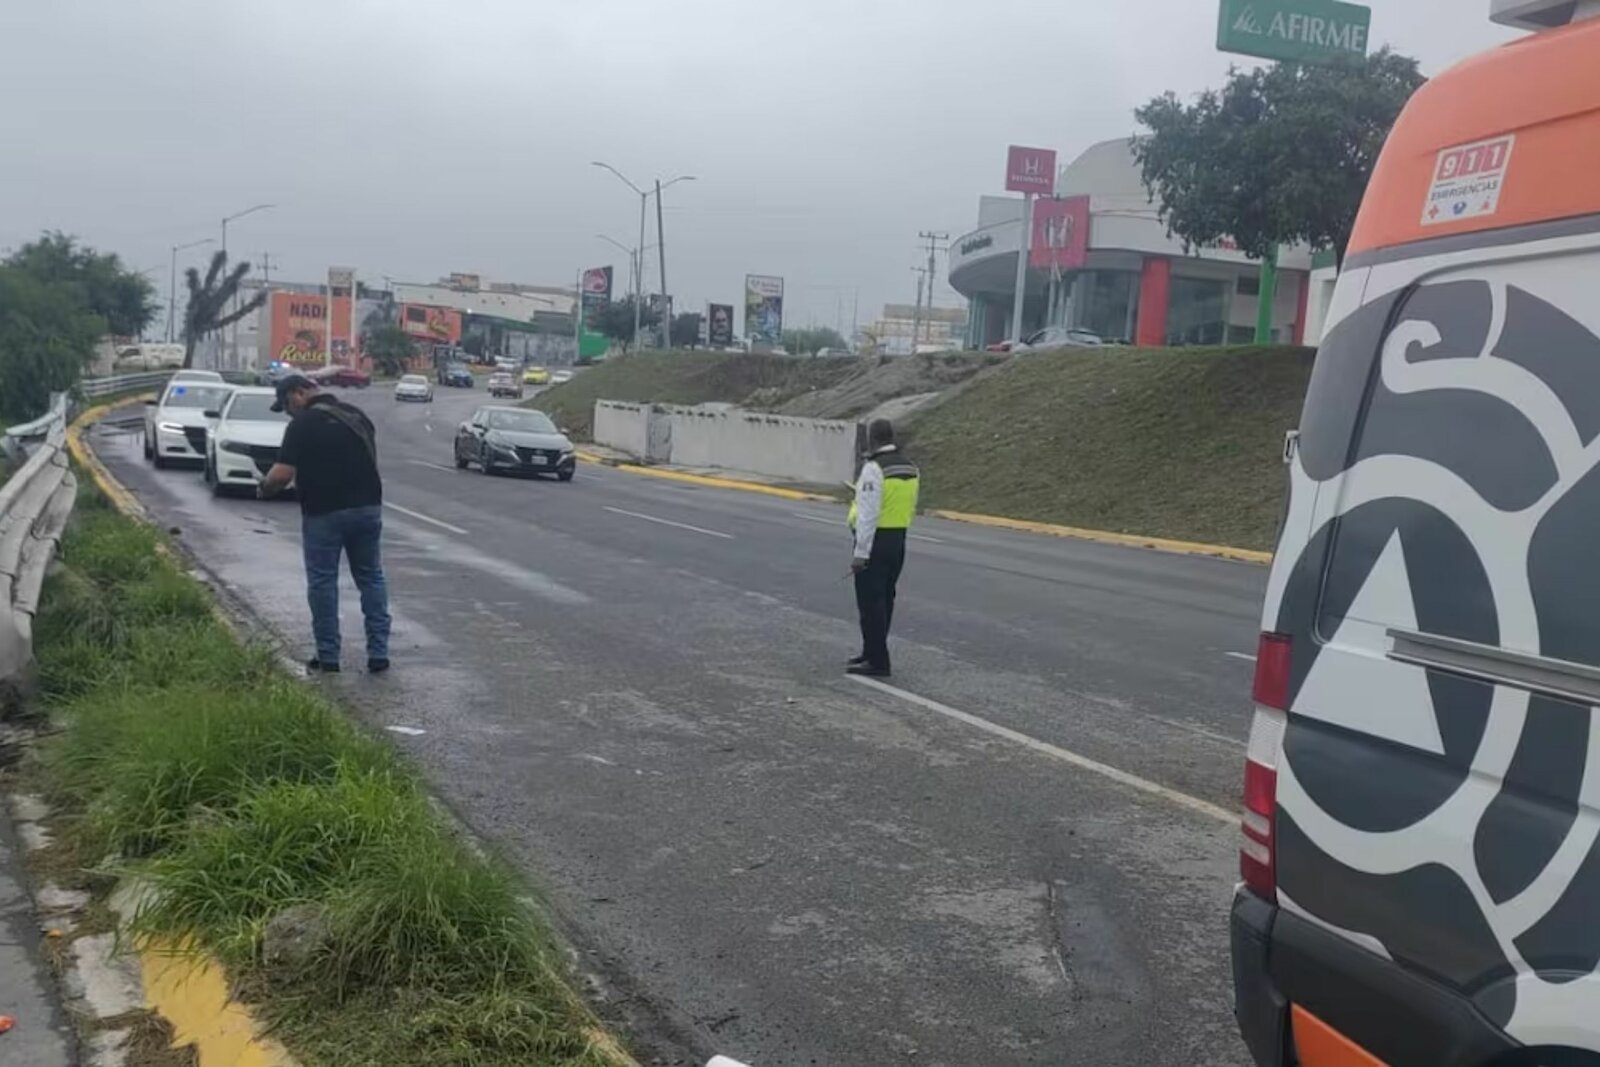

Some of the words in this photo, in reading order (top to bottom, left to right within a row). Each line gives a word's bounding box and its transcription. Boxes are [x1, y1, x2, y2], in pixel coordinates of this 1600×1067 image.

[1266, 11, 1366, 52] AFIRME
[1443, 145, 1501, 177] 911
[1011, 173, 1050, 185] HONDA
[1430, 180, 1498, 201] EMERGENCIAS
